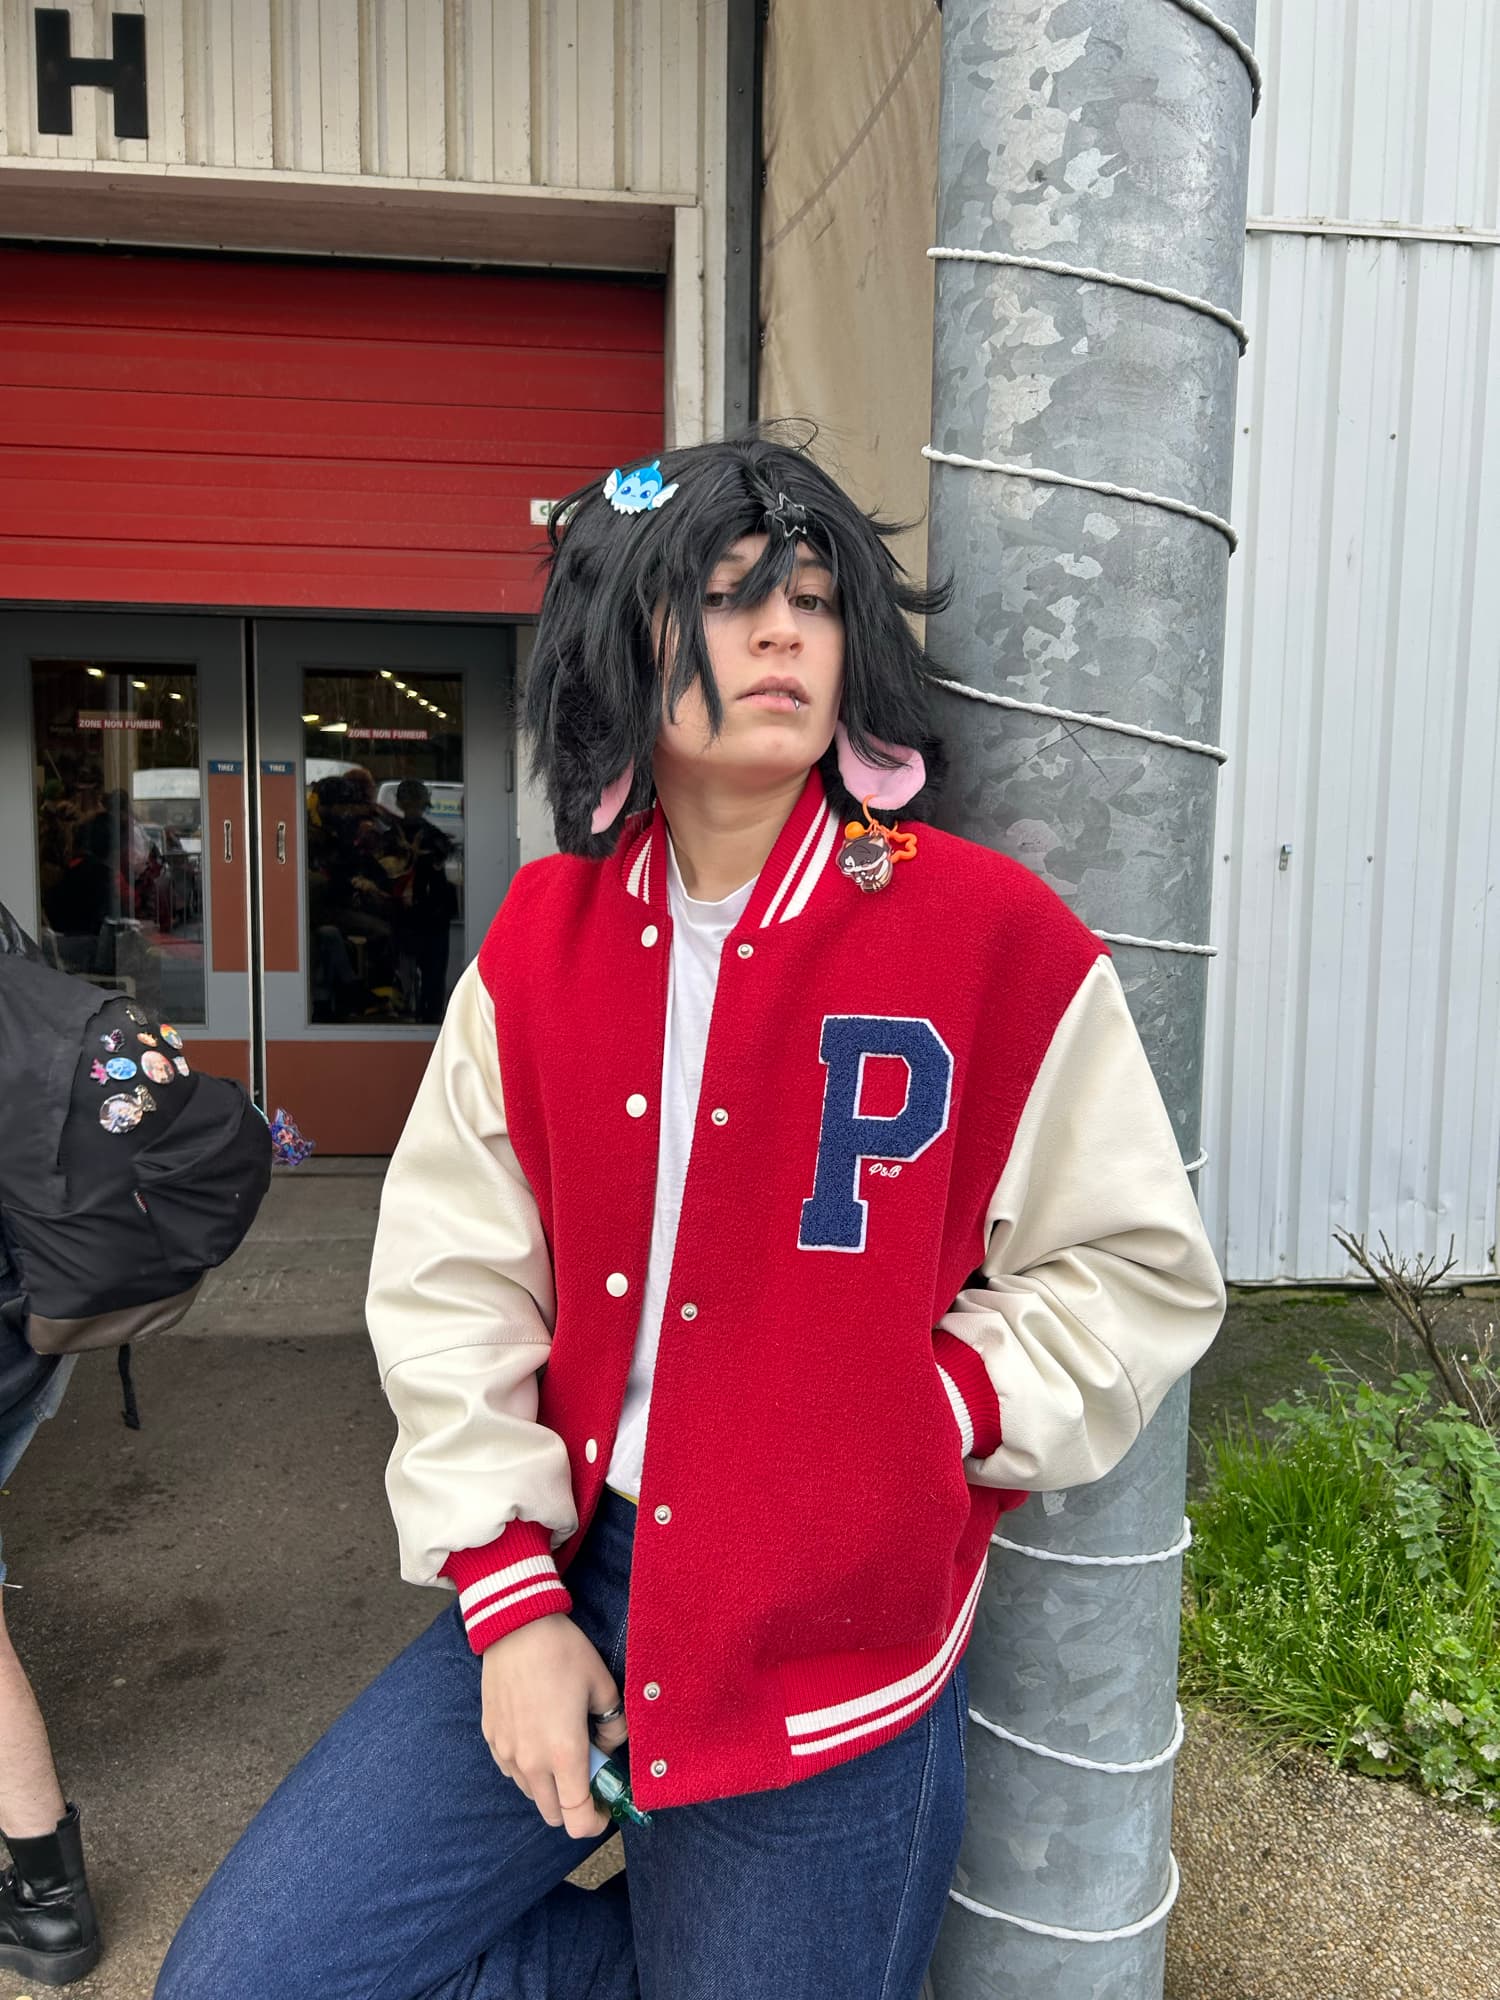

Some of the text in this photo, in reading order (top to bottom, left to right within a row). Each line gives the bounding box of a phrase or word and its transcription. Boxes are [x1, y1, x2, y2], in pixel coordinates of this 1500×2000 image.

[34, 7, 149, 140] H
[79, 719, 162, 730] ZONE NON FUMEUR
[348, 728, 428, 740] ZONE NON FUMEUR
[797, 1014, 954, 1254] P
